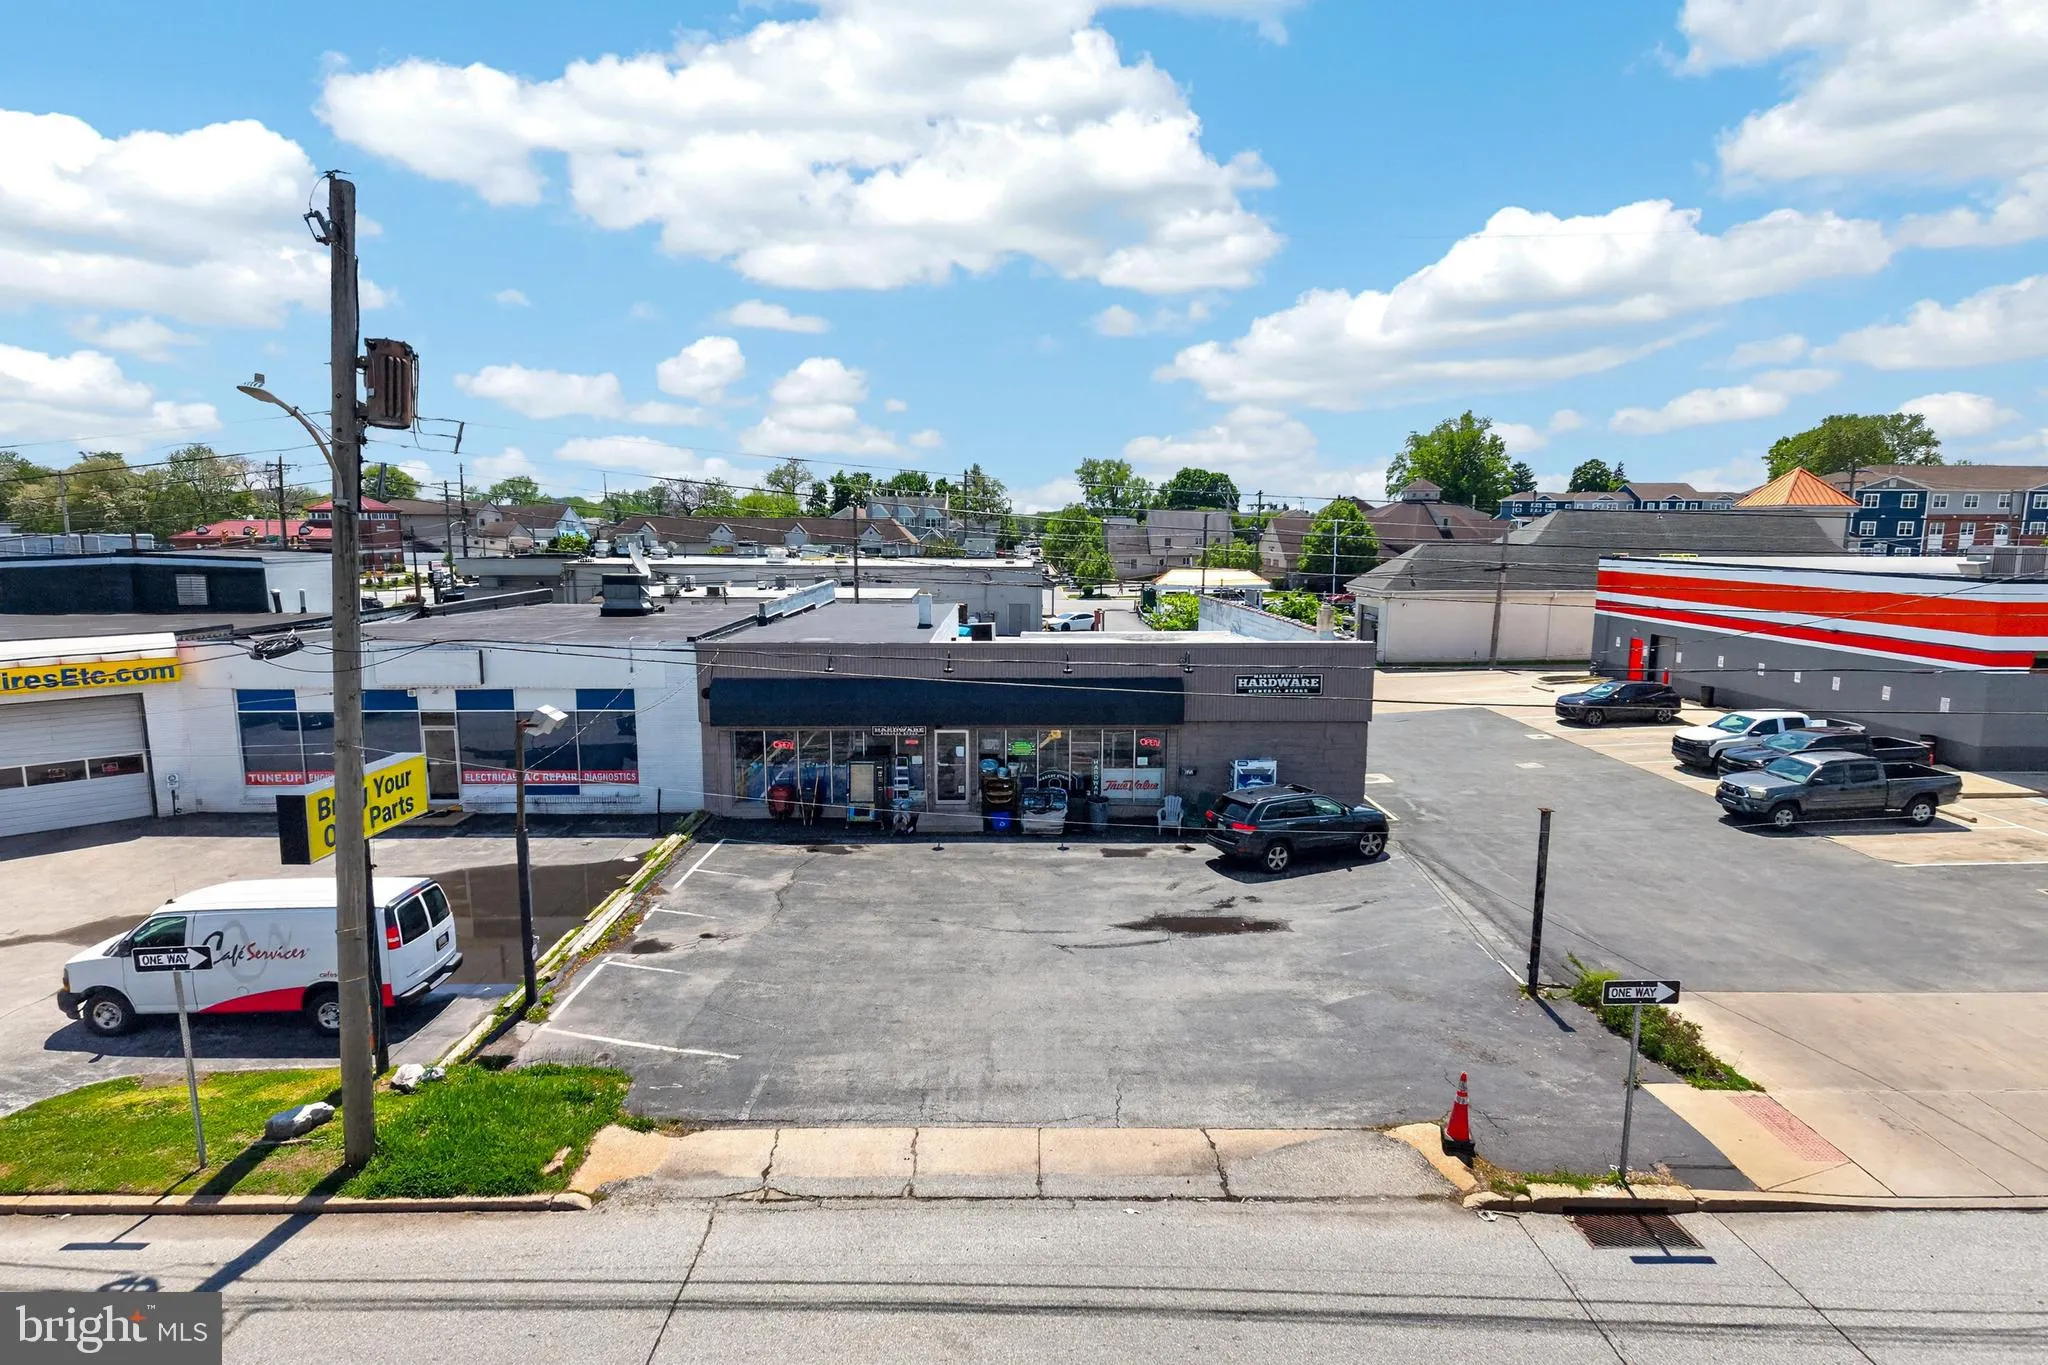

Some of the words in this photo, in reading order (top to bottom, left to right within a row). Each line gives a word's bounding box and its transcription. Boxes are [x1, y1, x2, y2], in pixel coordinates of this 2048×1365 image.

[1, 665, 175, 690] iresEtc.com
[1238, 678, 1319, 687] HARDWARE
[1140, 738, 1161, 747] OPEN
[248, 773, 303, 783] TUNE-UP
[543, 773, 578, 782] REPAIR
[584, 773, 636, 782] DIAGNOSTICS
[373, 769, 412, 799] Your
[1103, 780, 1128, 791] True
[369, 796, 414, 829] Parts
[142, 954, 164, 966] ONE
[166, 953, 188, 964] WAY
[1611, 987, 1632, 998] ONE
[1635, 987, 1657, 998] WAY
